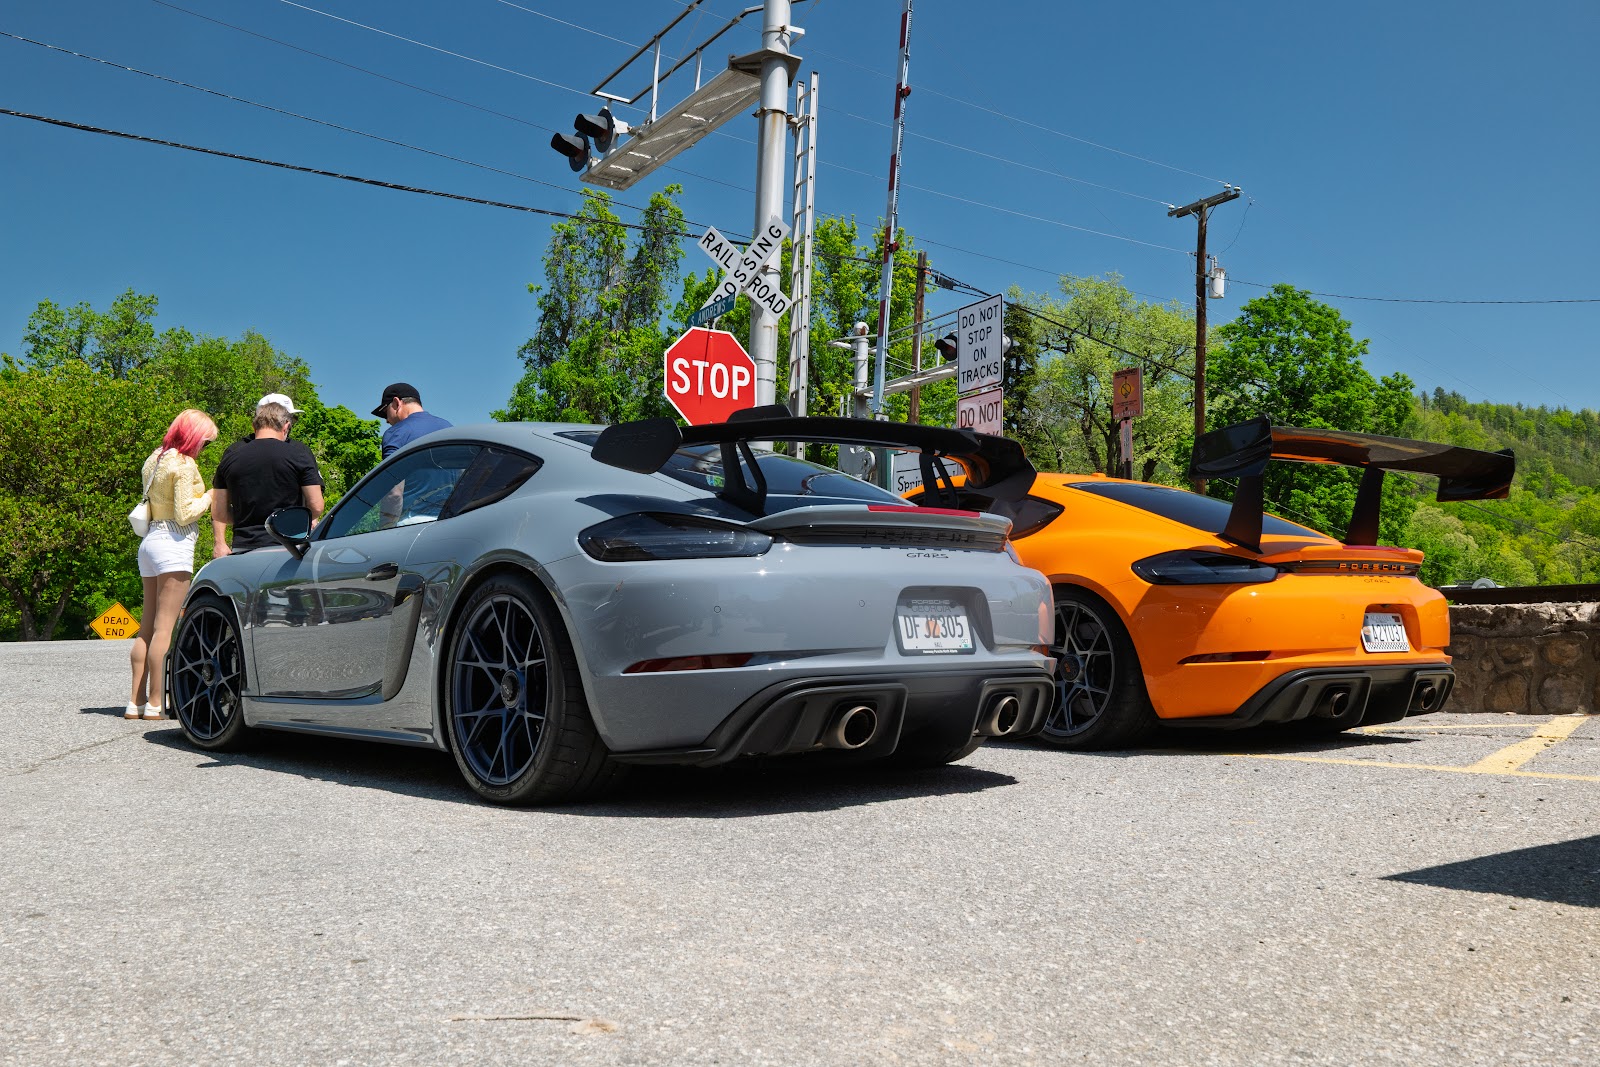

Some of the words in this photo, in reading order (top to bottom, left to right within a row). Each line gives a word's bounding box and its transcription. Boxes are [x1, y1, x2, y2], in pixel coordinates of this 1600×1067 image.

[701, 231, 734, 270] RAIL
[749, 275, 786, 315] ROAD
[697, 300, 726, 325] ANDREWS
[962, 314, 975, 329] DO
[979, 304, 999, 324] NOT
[967, 326, 993, 346] STOP
[973, 347, 987, 362] ON
[671, 356, 751, 401] STOP
[961, 361, 999, 385] TRACKS
[960, 408, 975, 428] DO
[978, 400, 999, 424] NOT
[1339, 563, 1405, 571] PORSCHE
[103, 617, 129, 625] DEAD
[911, 605, 952, 613] GEORGIA
[105, 628, 124, 636] END
